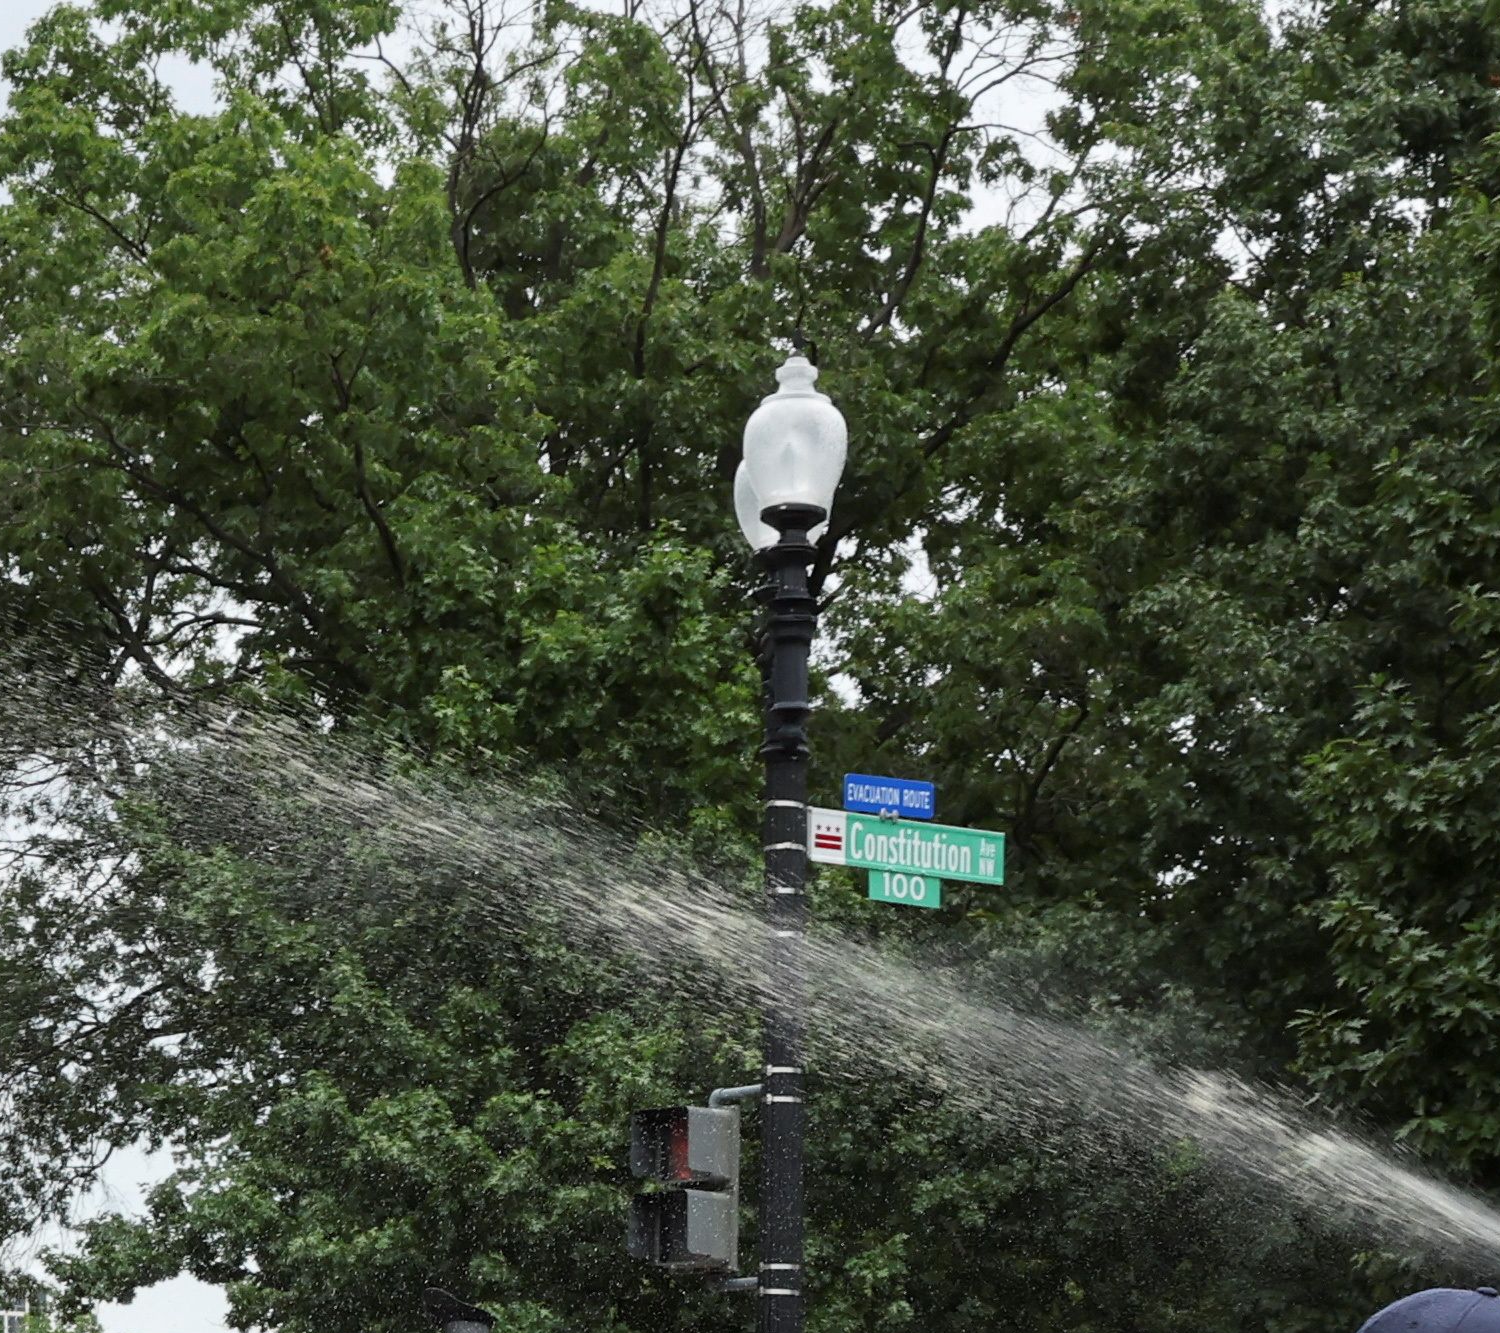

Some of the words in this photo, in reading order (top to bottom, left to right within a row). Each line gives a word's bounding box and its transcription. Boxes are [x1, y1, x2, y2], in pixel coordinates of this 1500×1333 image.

[847, 782, 900, 806] EVACUATION
[903, 788, 931, 810] ROUTE
[850, 821, 971, 874] Constitution
[979, 837, 996, 857] Ave
[978, 857, 996, 877] NW
[882, 872, 926, 900] 100
